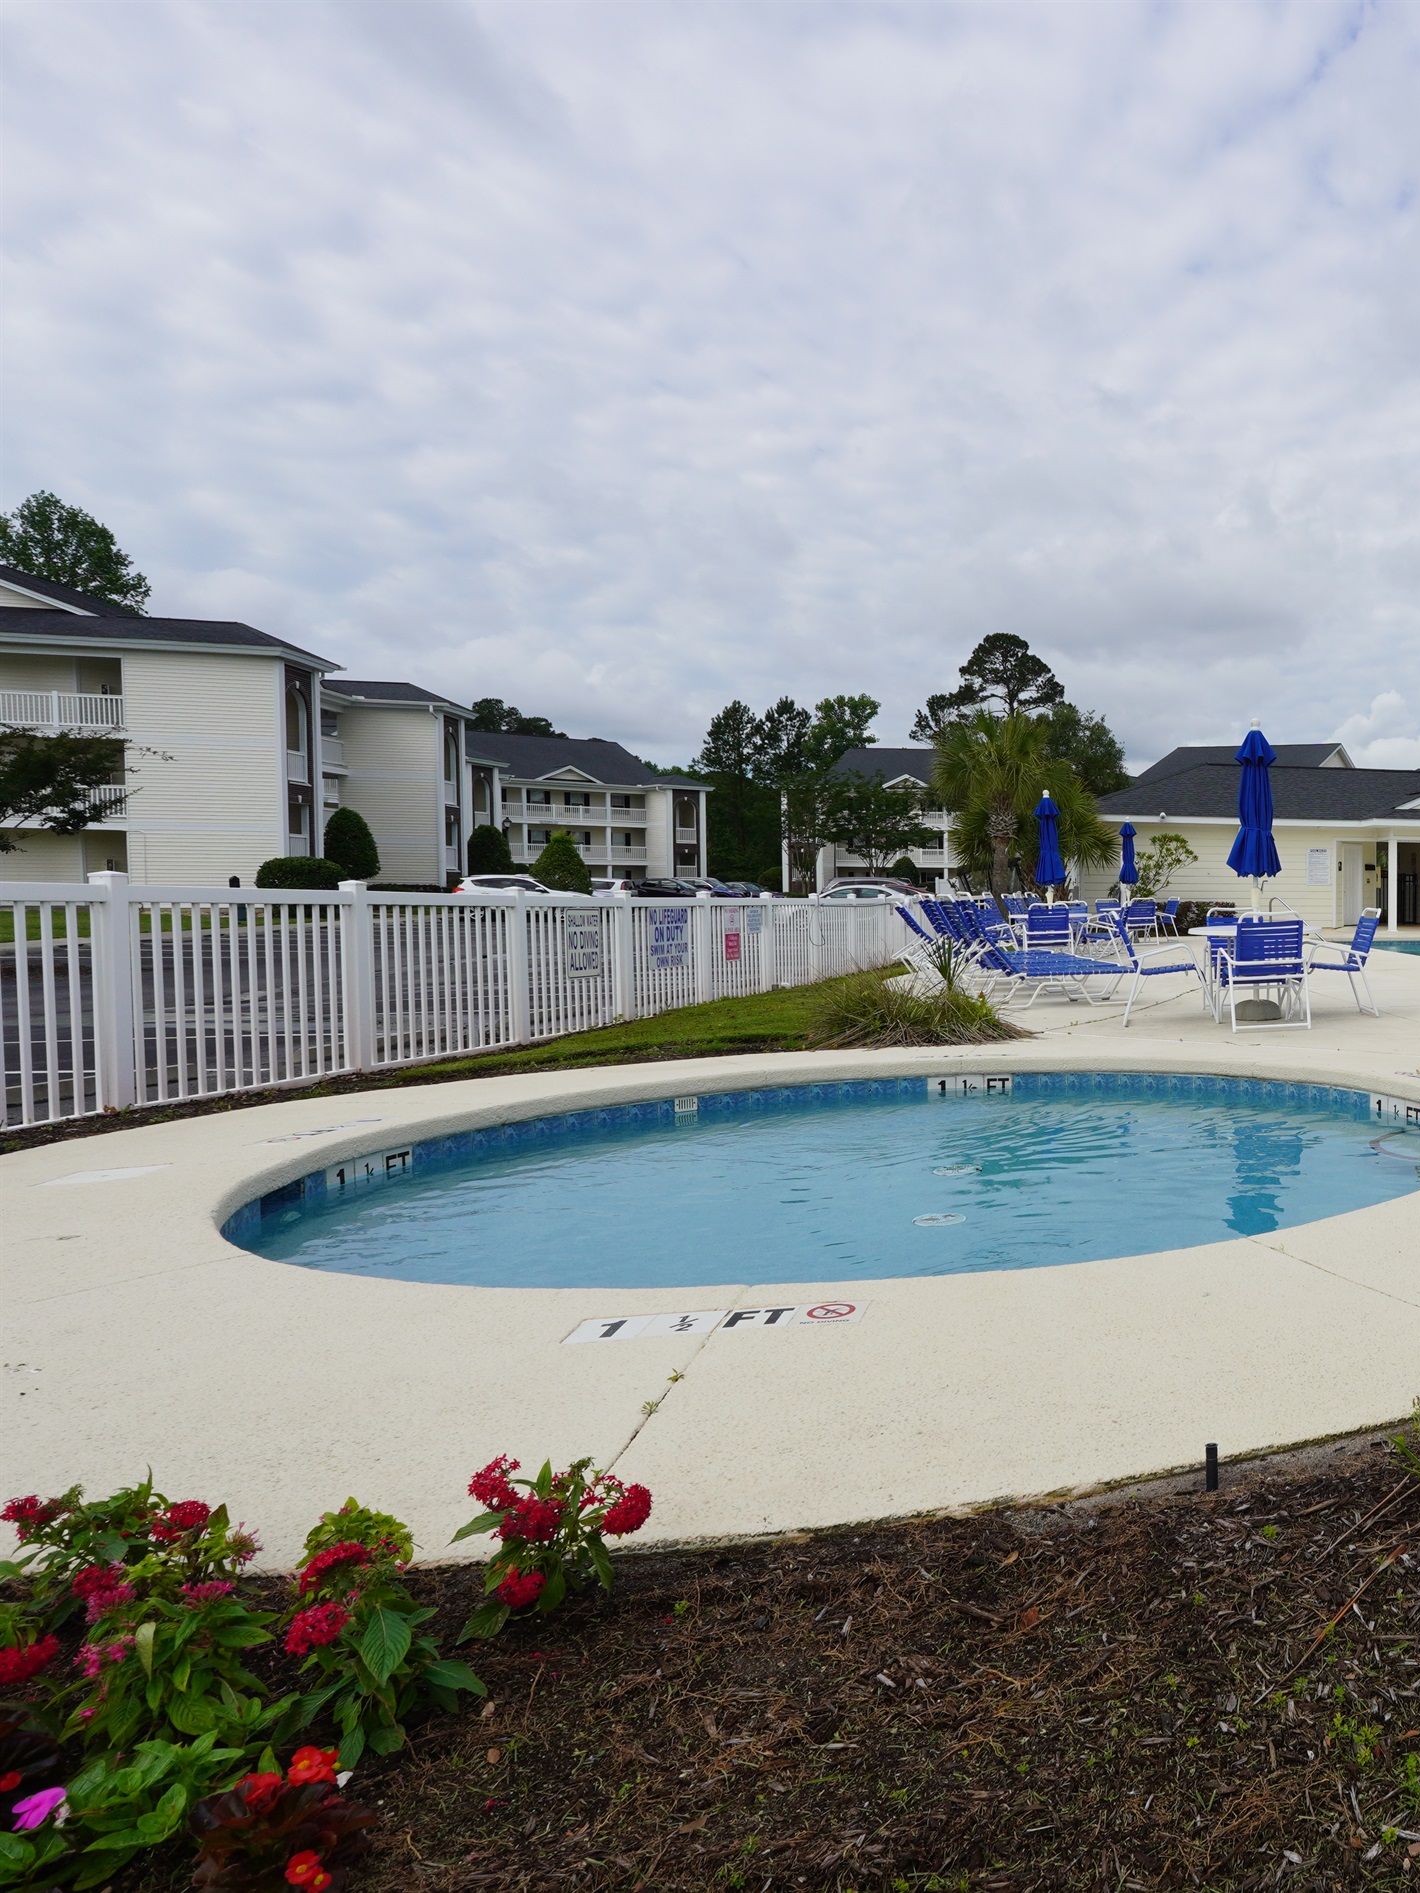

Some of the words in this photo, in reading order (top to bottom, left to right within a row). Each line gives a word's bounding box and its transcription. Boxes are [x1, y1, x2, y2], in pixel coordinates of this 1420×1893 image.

[649, 908, 657, 925] NO
[658, 908, 688, 925] LIFEGUARD
[568, 931, 578, 949] NO
[579, 930, 598, 949] DIVING
[654, 926, 665, 943] ON
[666, 925, 684, 942] DUTY
[650, 944, 665, 956] SWIM
[666, 943, 673, 955] AT
[673, 942, 688, 953] YOUR
[570, 951, 598, 971] ALLOWED
[656, 956, 669, 968] OWN
[670, 955, 683, 966] RISK
[938, 1080, 946, 1091] 1
[987, 1078, 1009, 1090] FT
[1376, 1099, 1381, 1112] 1
[1406, 1106, 1420, 1120] FT
[336, 1168, 345, 1185] 1
[386, 1151, 409, 1171] FT
[598, 1319, 628, 1339] 1
[722, 1307, 796, 1329] FT
